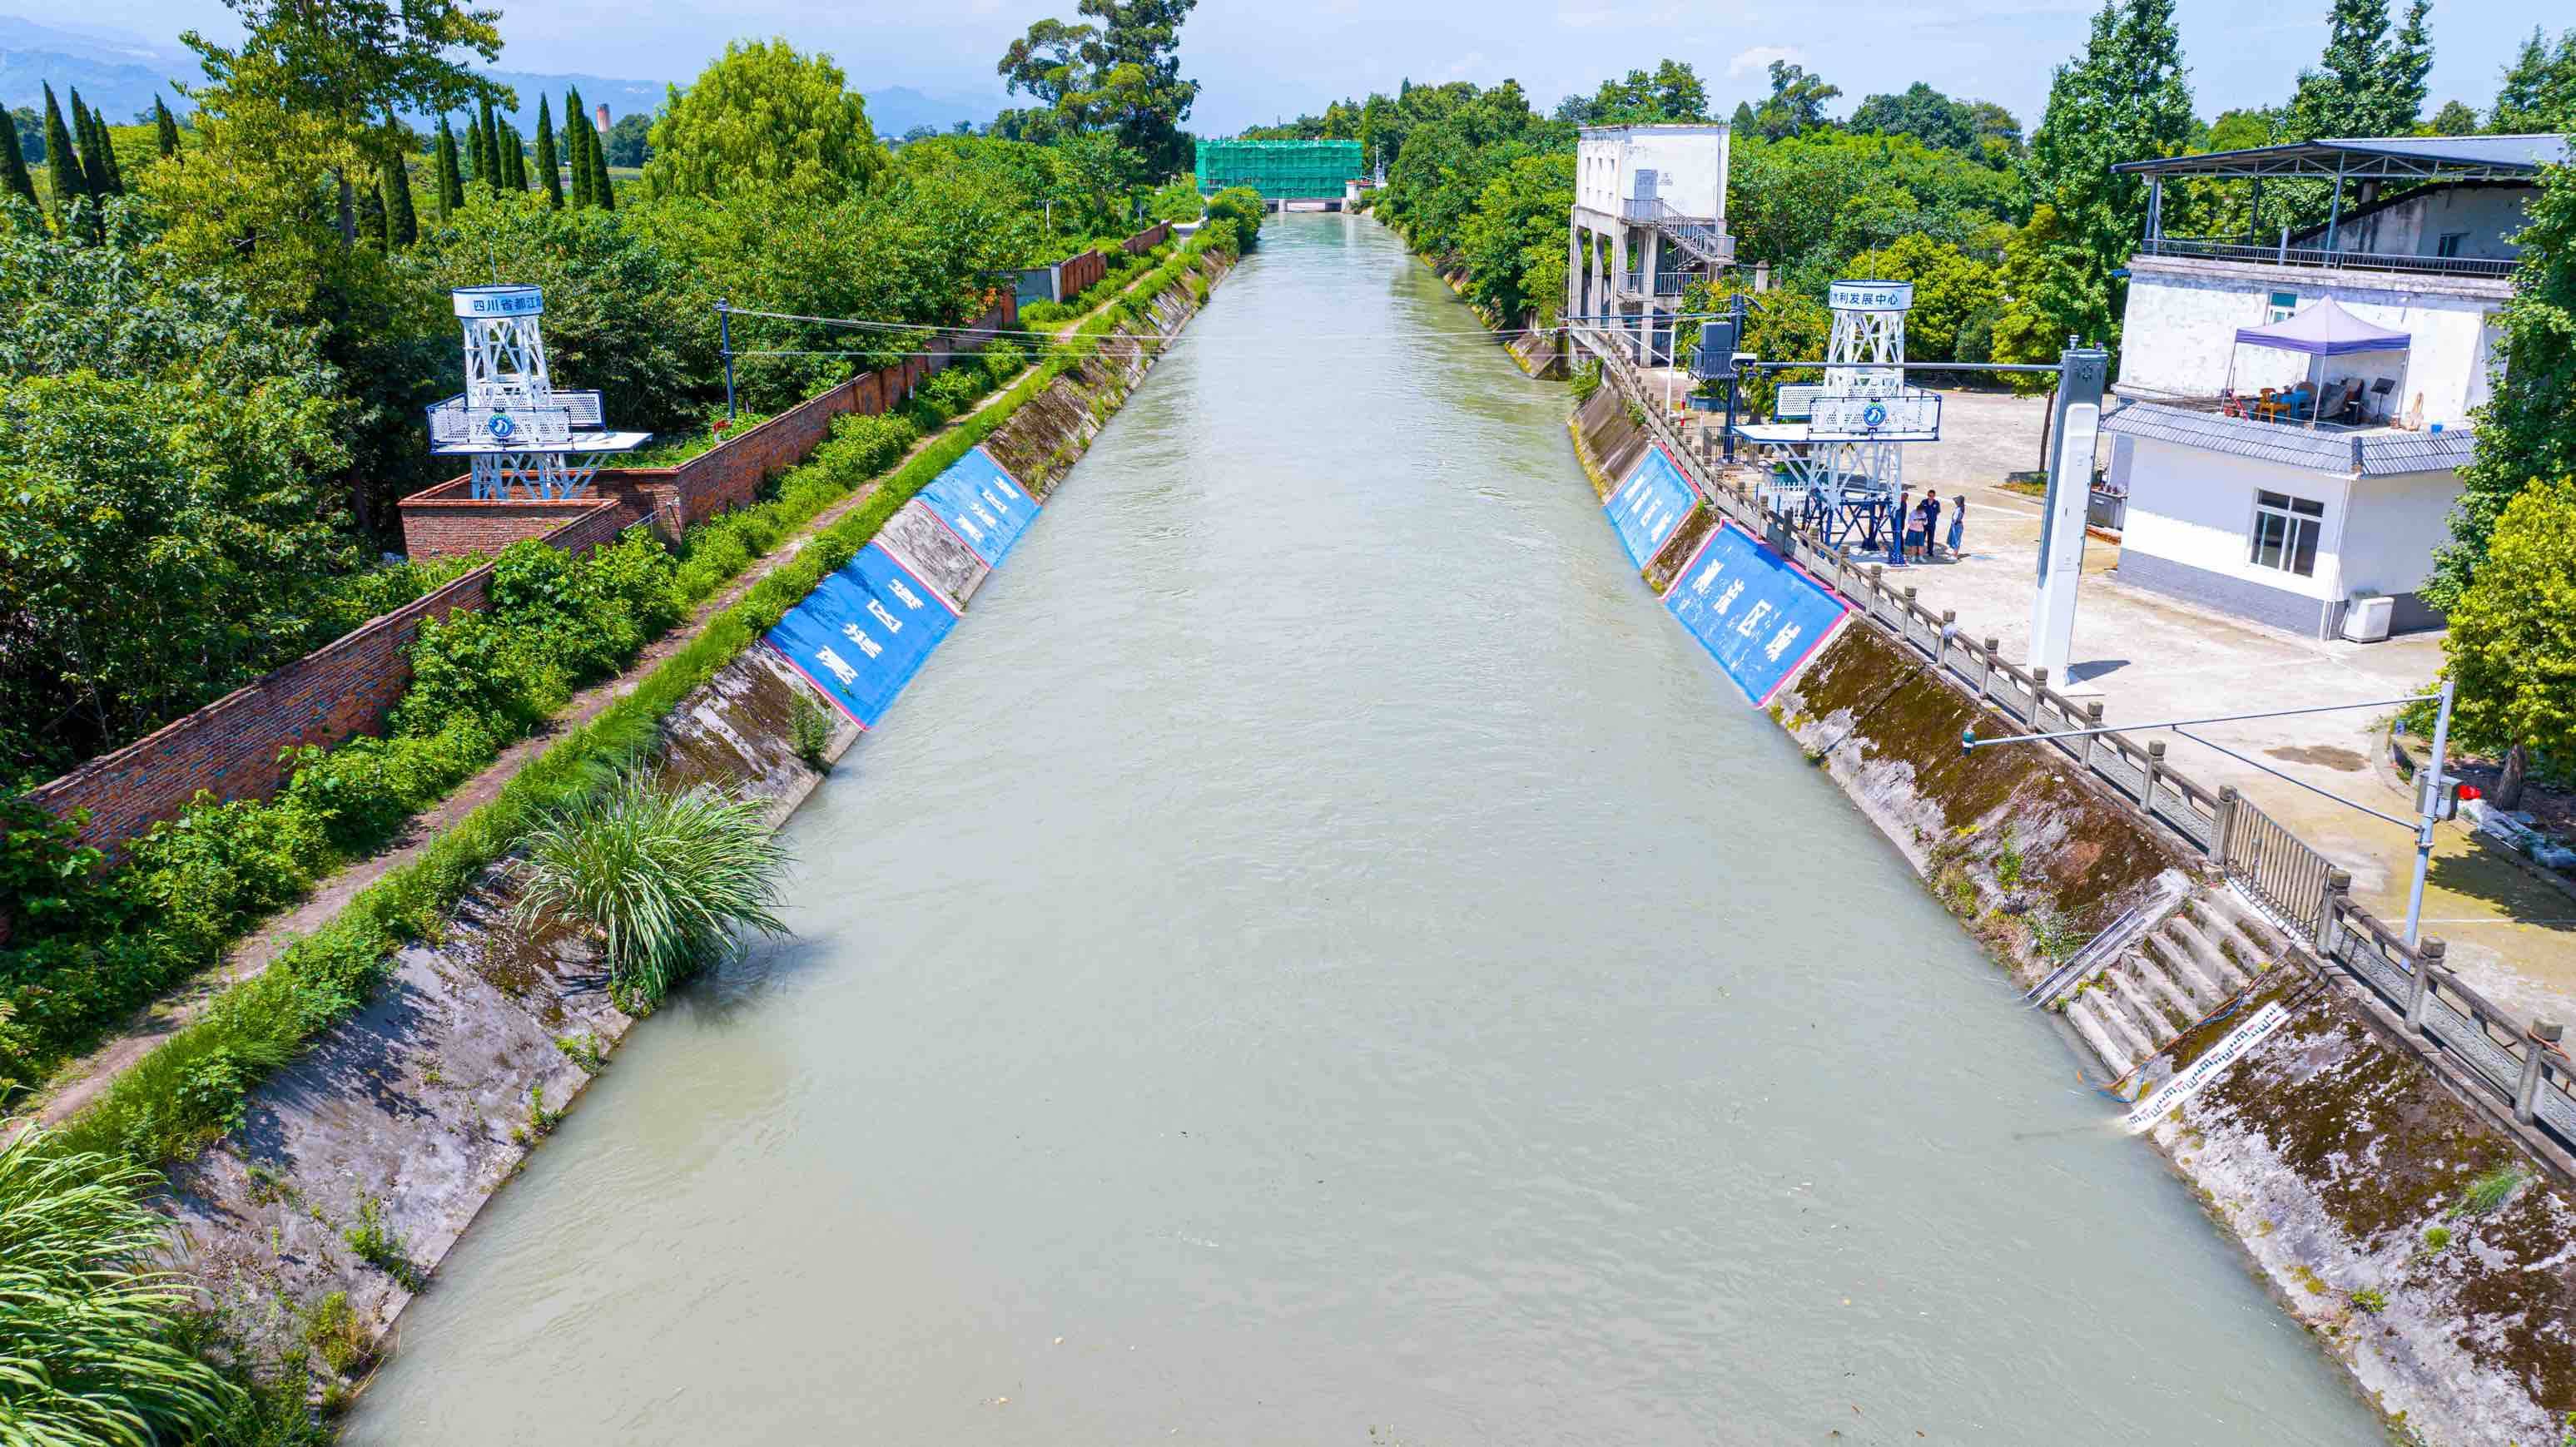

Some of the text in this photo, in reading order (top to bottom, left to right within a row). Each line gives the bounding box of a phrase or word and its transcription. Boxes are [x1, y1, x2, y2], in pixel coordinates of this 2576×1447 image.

[1829, 291, 1898, 305] 水利发展中心
[815, 578, 926, 686] 测流区域
[1690, 558, 1803, 663] 测流区域
